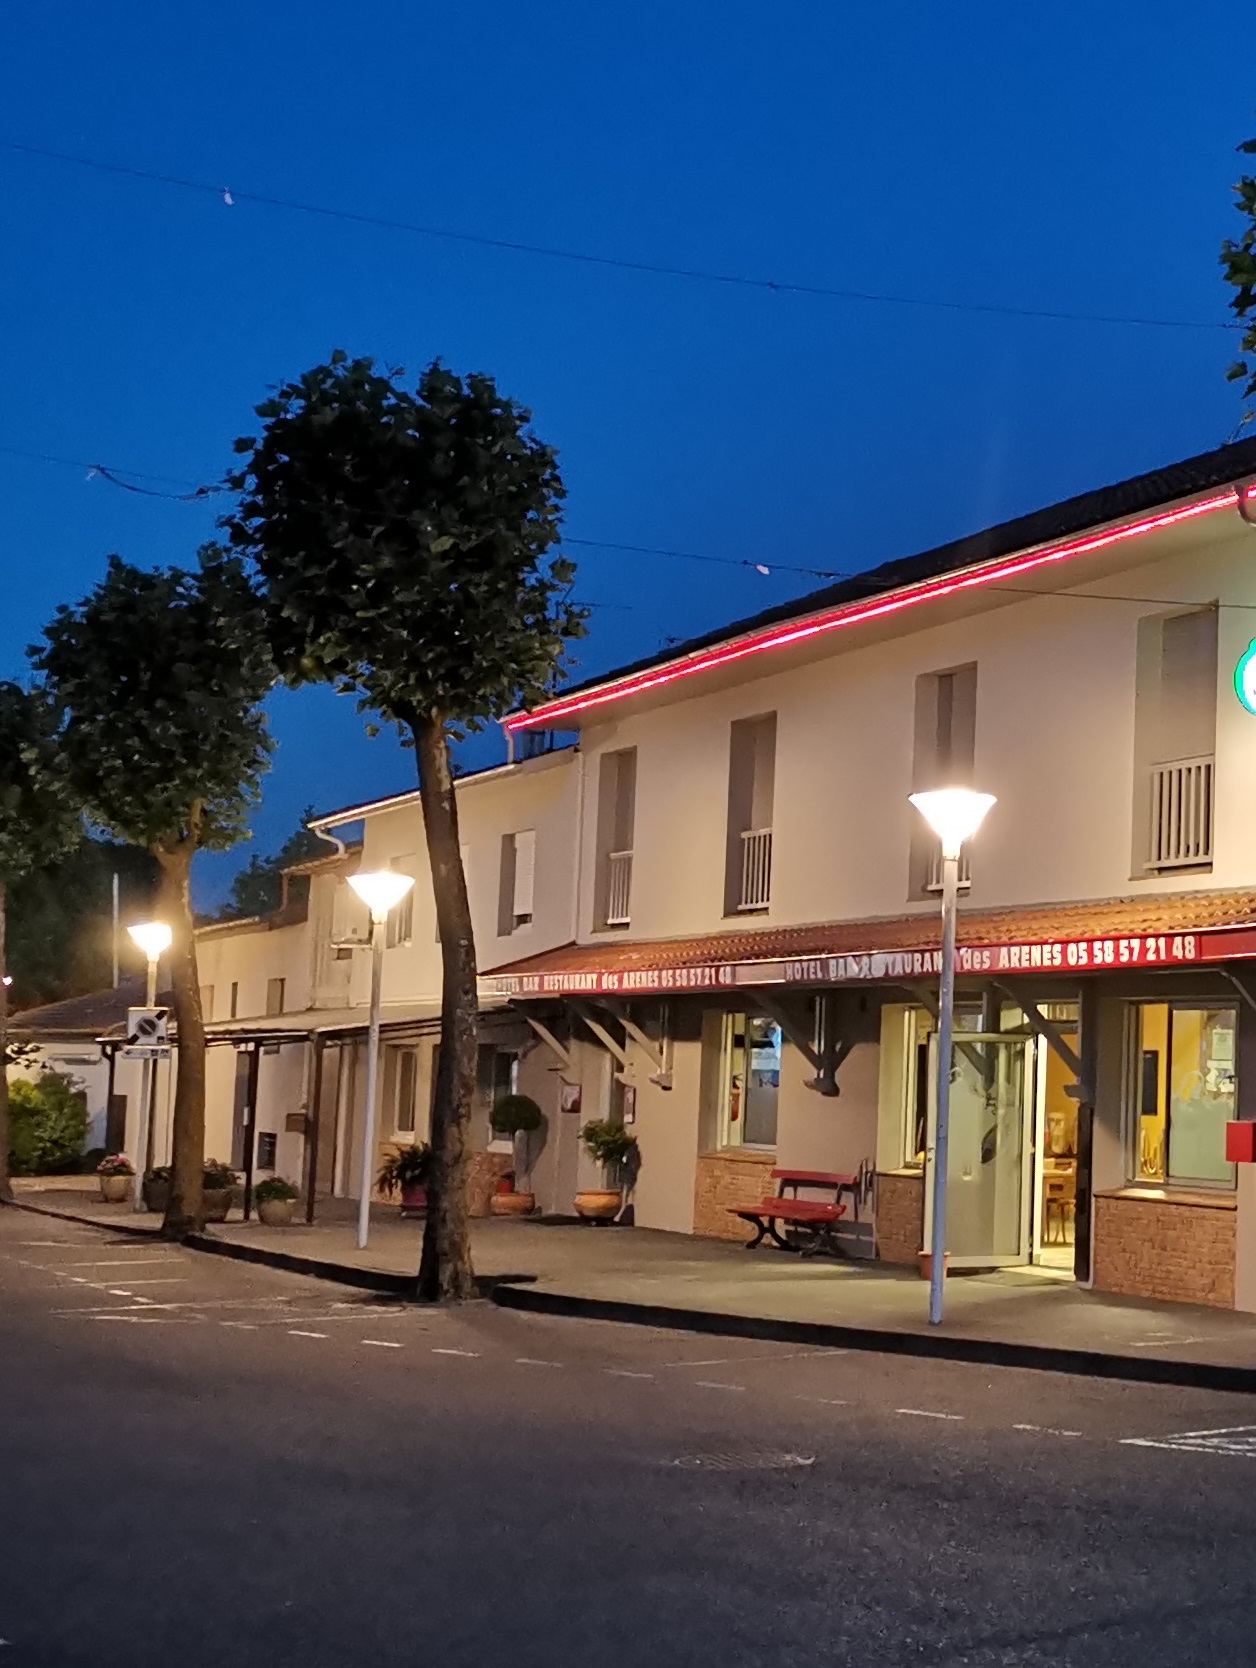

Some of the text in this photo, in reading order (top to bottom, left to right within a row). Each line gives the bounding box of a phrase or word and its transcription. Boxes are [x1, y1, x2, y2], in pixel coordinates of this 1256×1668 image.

[786, 960, 823, 980] HOTEL
[963, 948, 991, 970] des
[999, 943, 1063, 968] ARENES
[1067, 942, 1088, 965] 05
[1093, 940, 1114, 964] 58
[1119, 938, 1140, 963] 57
[1146, 937, 1167, 961] 21
[1172, 935, 1196, 960] 48
